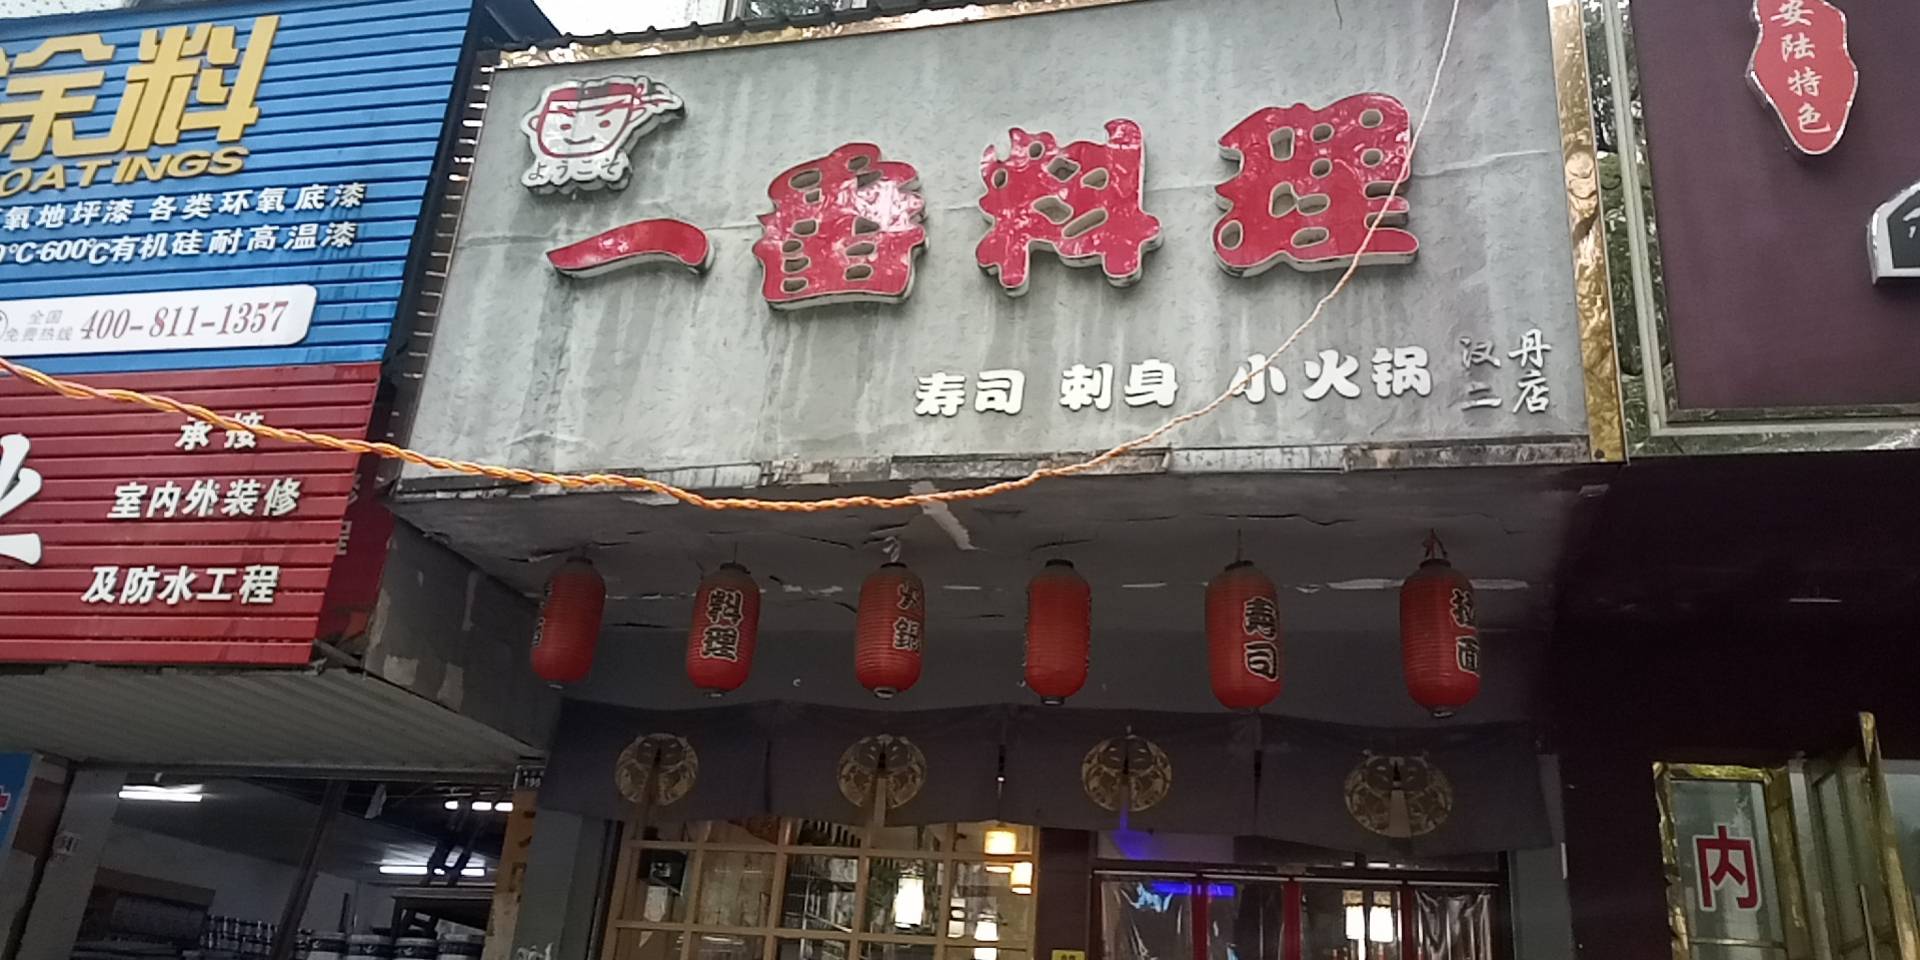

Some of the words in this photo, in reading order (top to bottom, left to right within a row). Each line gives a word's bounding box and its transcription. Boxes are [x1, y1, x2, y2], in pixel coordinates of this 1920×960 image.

[1770, 0, 1831, 134] 安陆特色
[528, 158, 621, 181] ようこそ
[0, 199, 135, 232] 氧地坪漆
[148, 183, 366, 223] 各类环氧底漆
[546, 92, 1420, 311] 一番料理
[80, 301, 289, 341] 400-811-1357
[914, 369, 1026, 418] 寿司
[1059, 358, 1179, 412] 刺身
[1228, 346, 1433, 404] 小火锅
[107, 479, 302, 520] 室内外装修
[81, 565, 280, 605] 及防水工程
[699, 588, 744, 662] 料理
[1694, 824, 1761, 911] 内
